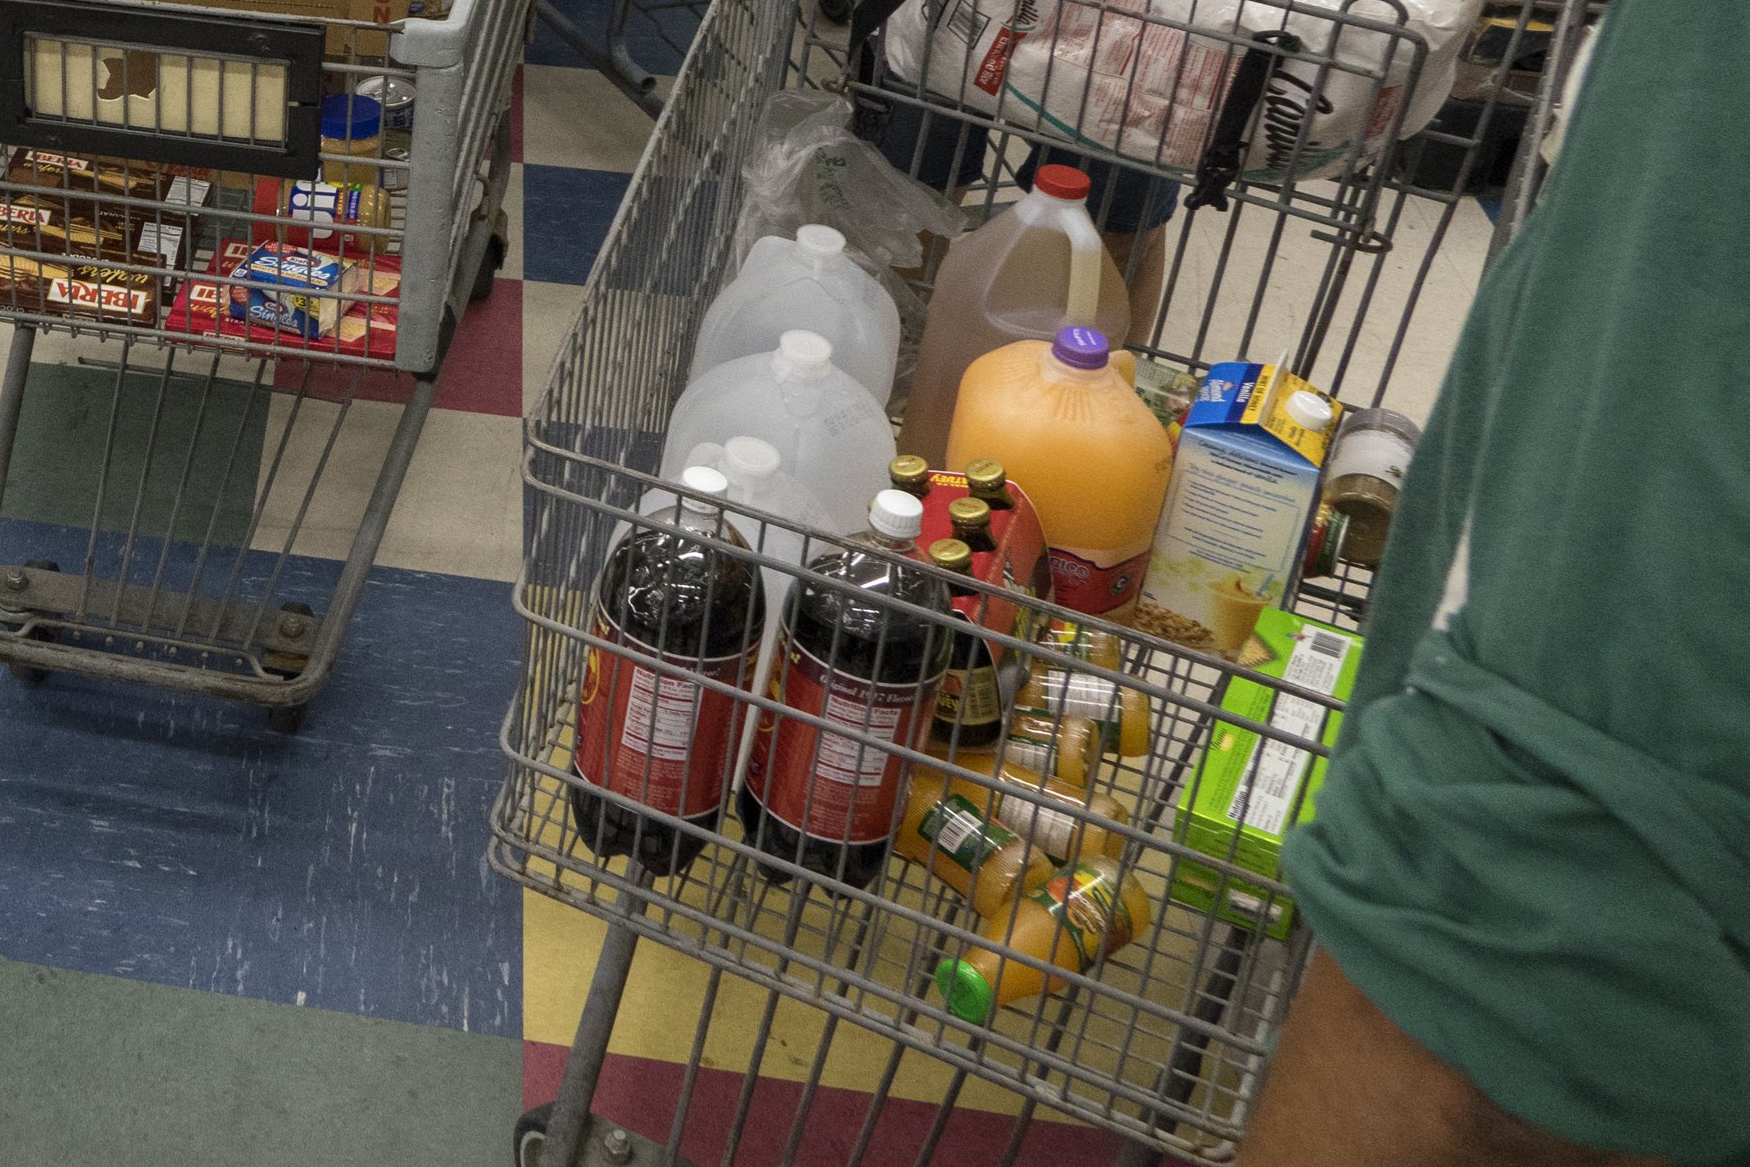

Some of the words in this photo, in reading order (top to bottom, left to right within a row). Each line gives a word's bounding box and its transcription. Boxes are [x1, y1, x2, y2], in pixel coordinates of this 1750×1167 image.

[33, 151, 84, 170] BERIA
[56, 280, 141, 310] IBERIA
[930, 473, 970, 485] ATUEY
[1051, 555, 1090, 580] PICO
[857, 689, 885, 704] 197
[873, 706, 901, 719] Facts
